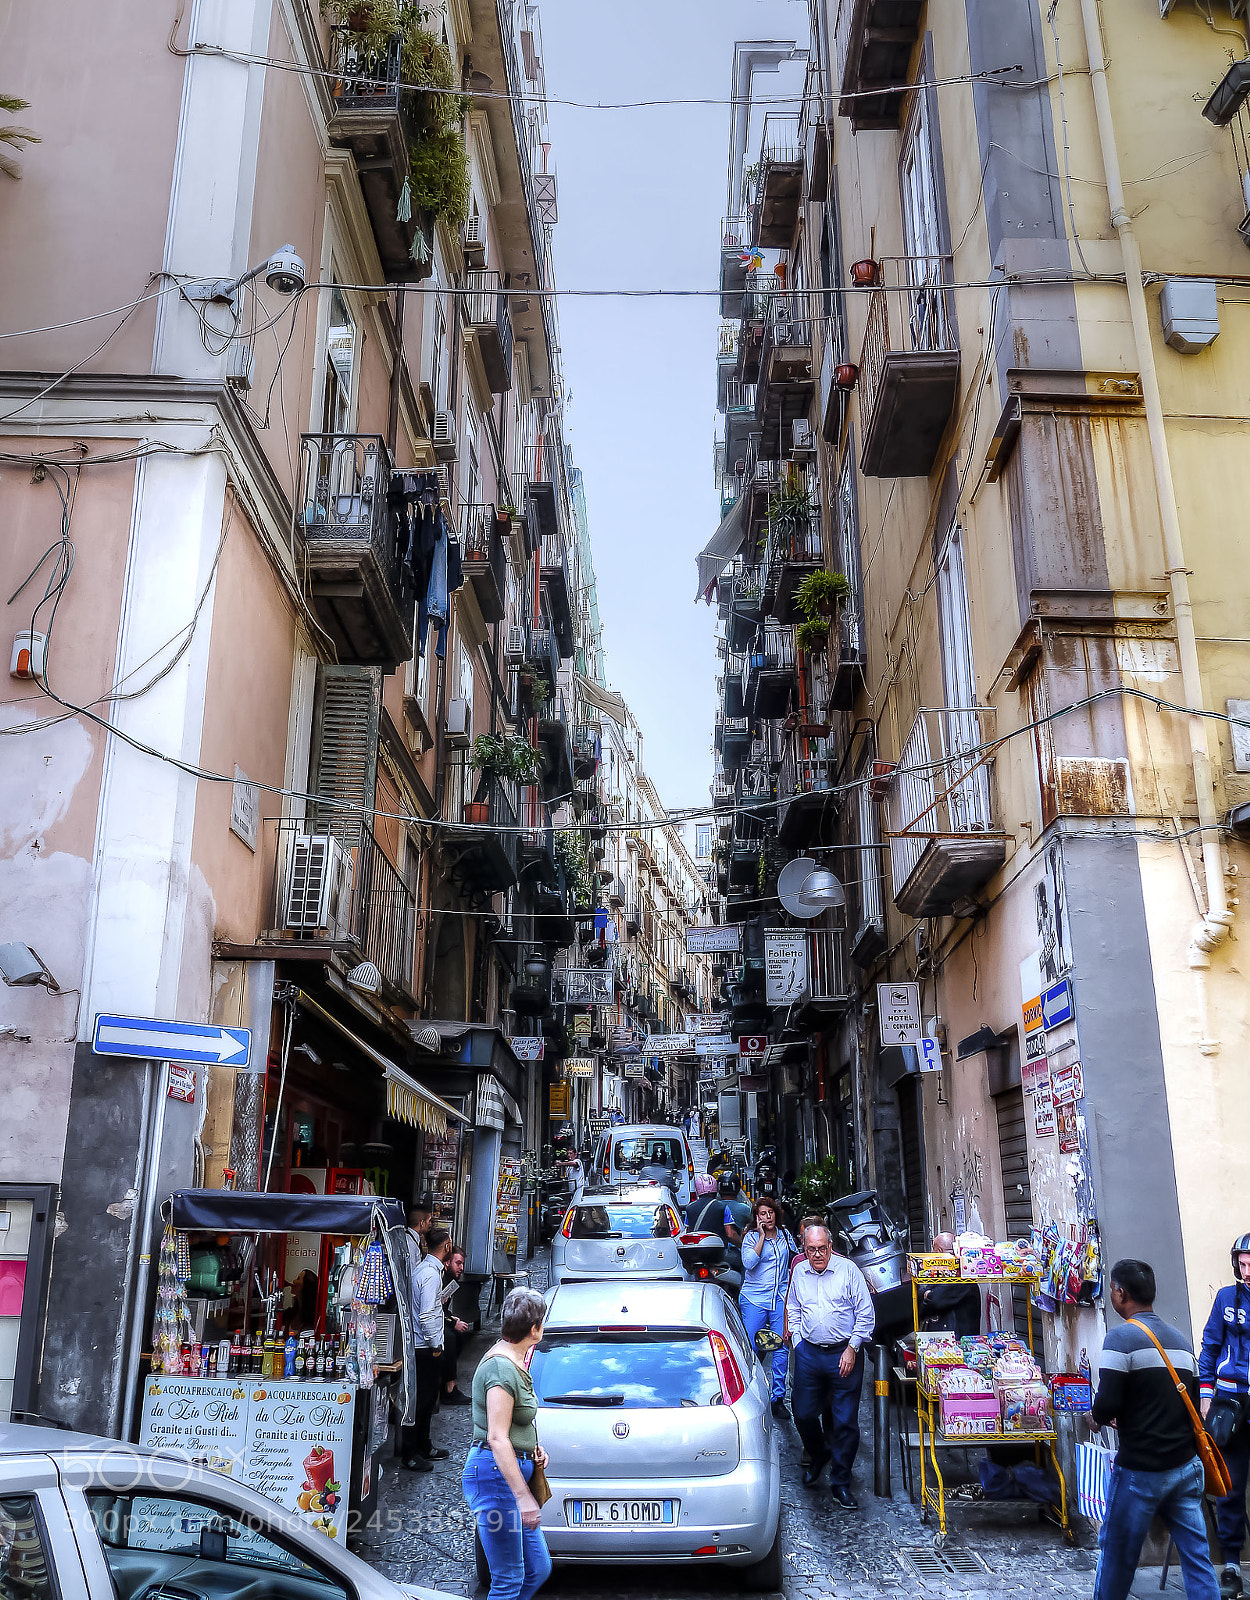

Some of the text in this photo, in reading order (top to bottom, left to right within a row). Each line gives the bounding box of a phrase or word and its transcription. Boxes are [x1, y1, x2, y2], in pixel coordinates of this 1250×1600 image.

[768, 949, 803, 957] Folletto
[922, 1039, 935, 1058] P
[162, 1385, 232, 1396] ACQUAFRESCAIO
[267, 1390, 337, 1401] ACQUAFRESCAIO
[150, 1399, 239, 1423] da Zio Rich
[255, 1404, 345, 1427] da Zio Rich
[150, 1423, 237, 1437] Granite ai Gusti di...
[255, 1428, 343, 1442] Granite ai Gusti di...
[147, 1436, 184, 1449] Kinder
[251, 1441, 289, 1453] Limone
[249, 1454, 293, 1471] Fragola
[248, 1468, 295, 1481] Arancia
[138, 1503, 177, 1517] Kinder
[585, 1502, 604, 1521] DL
[610, 1502, 661, 1521] 610MD
[138, 1520, 175, 1539] Bounty
